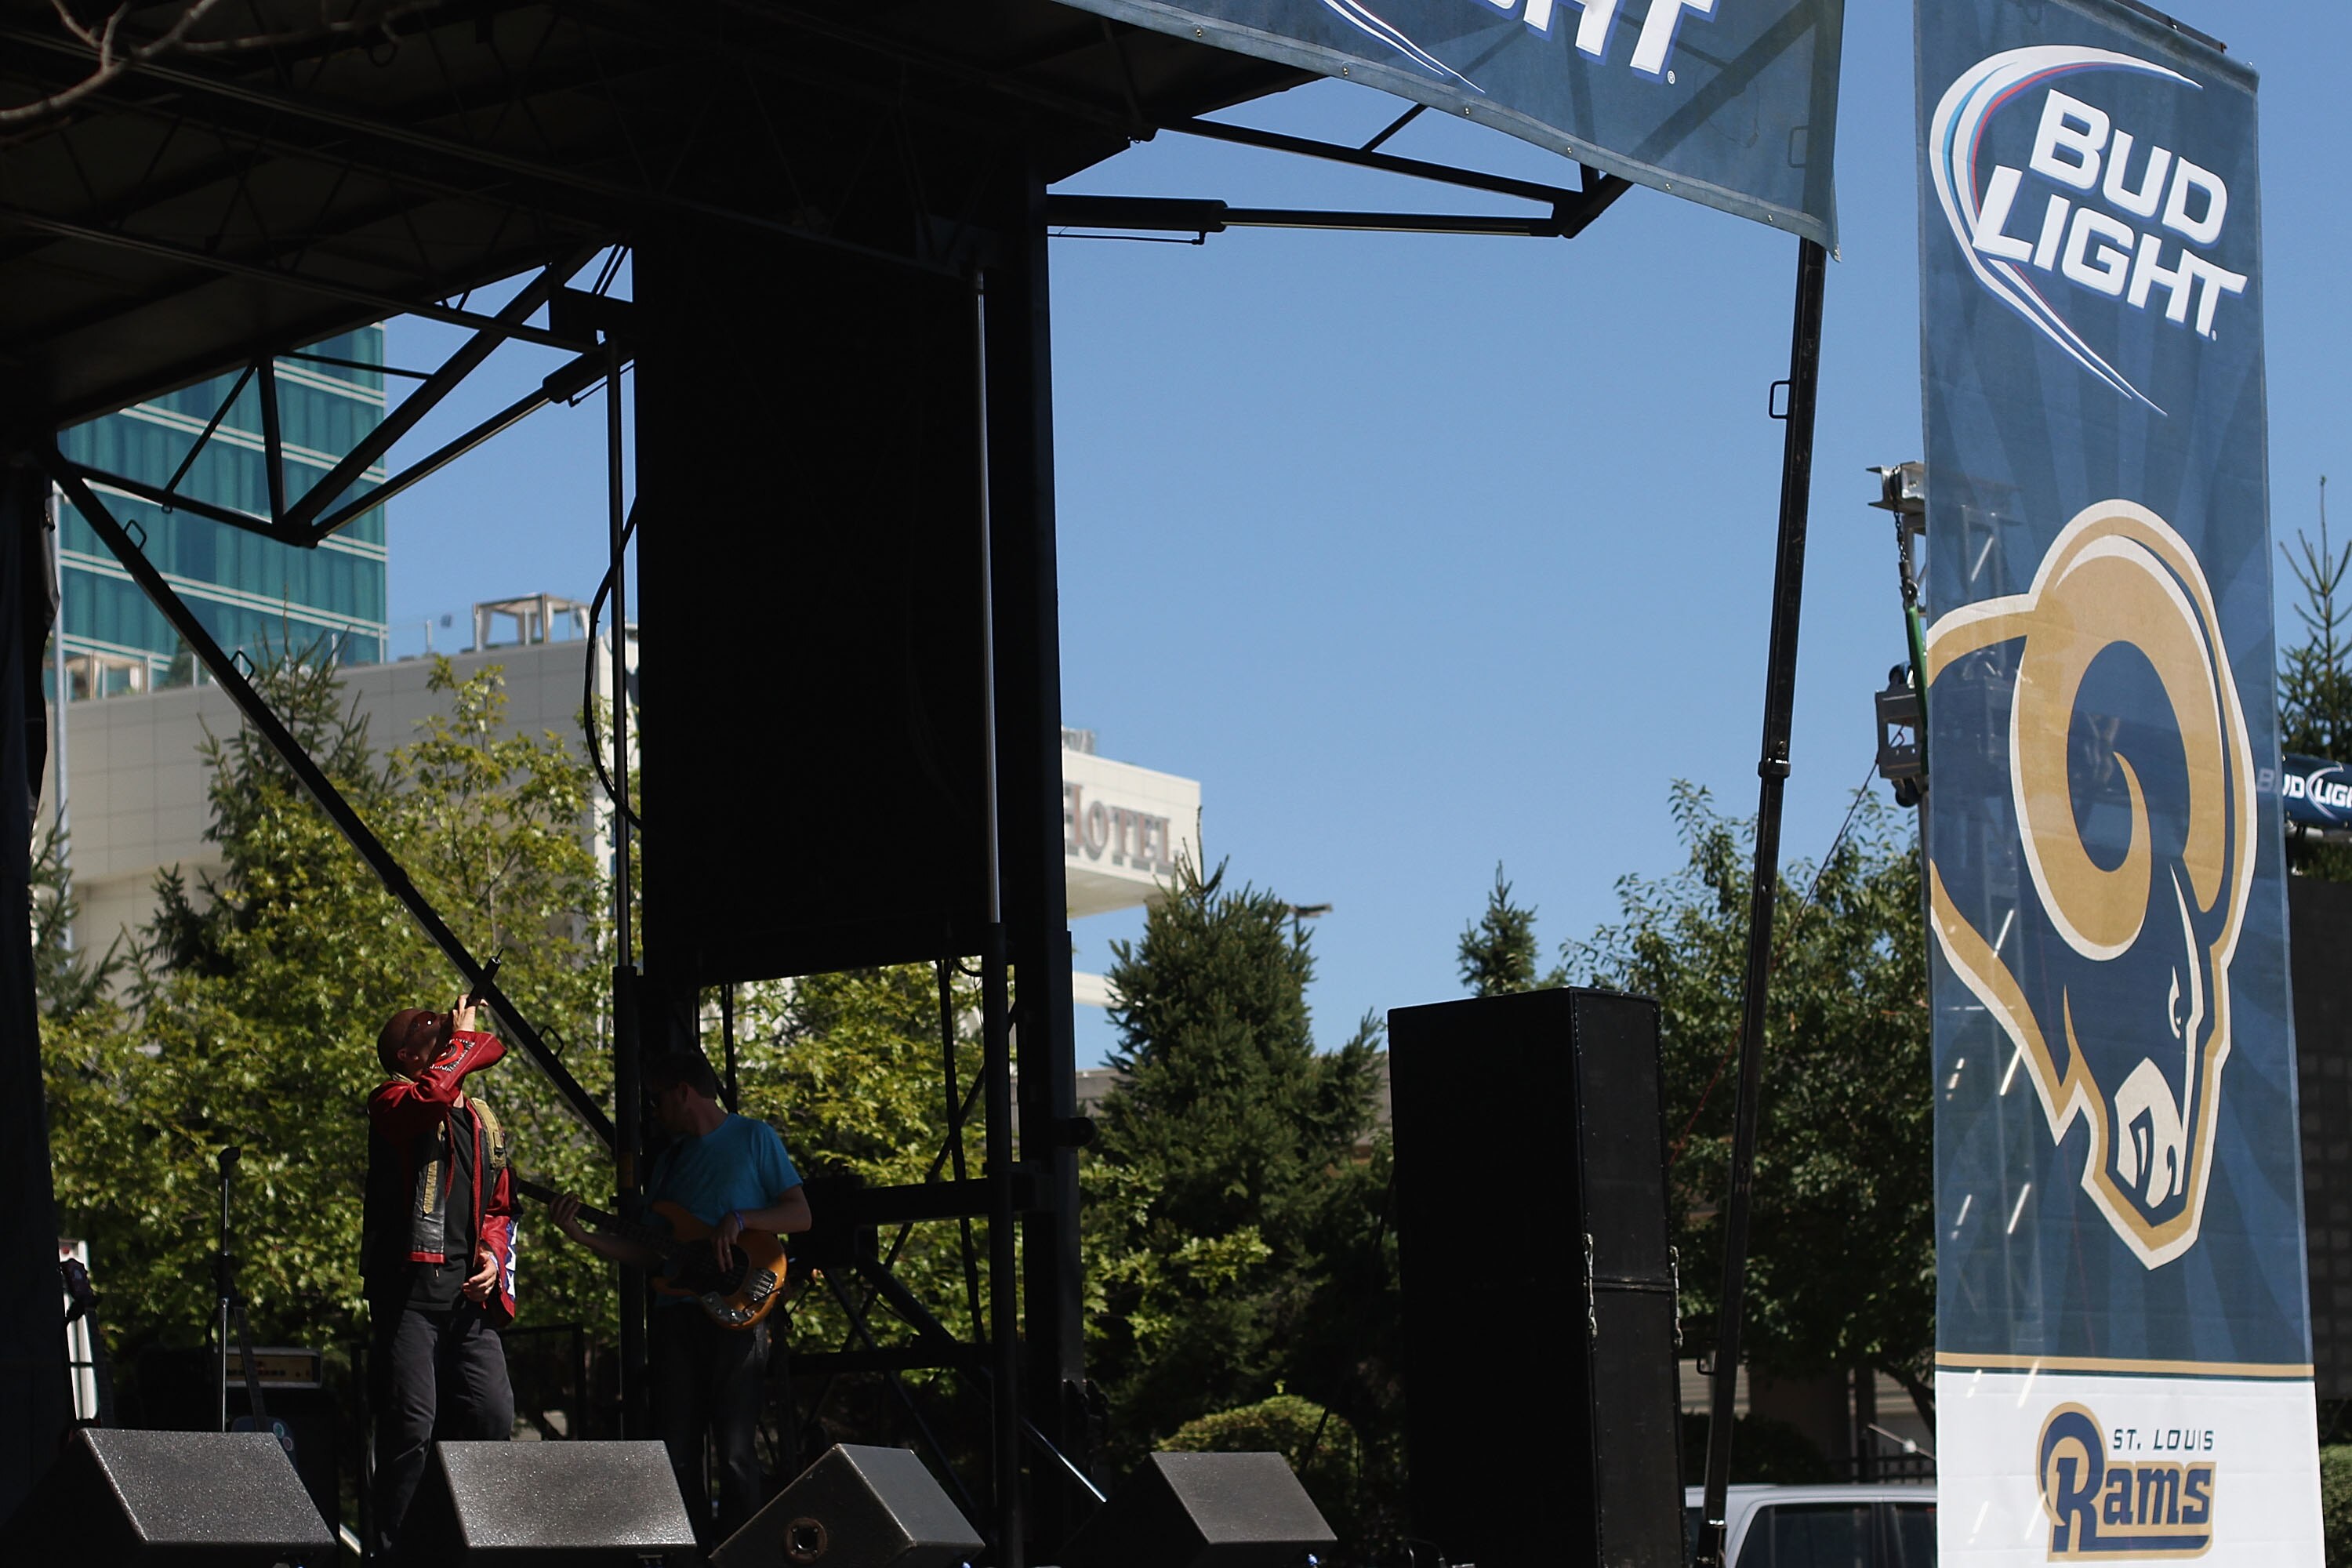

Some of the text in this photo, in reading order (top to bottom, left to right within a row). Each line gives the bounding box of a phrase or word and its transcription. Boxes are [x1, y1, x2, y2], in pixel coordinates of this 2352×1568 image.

[2029, 88, 2229, 245] BUD
[1972, 165, 2249, 339] LIGHT
[2113, 1428, 2215, 1452] ST. LOUIS
